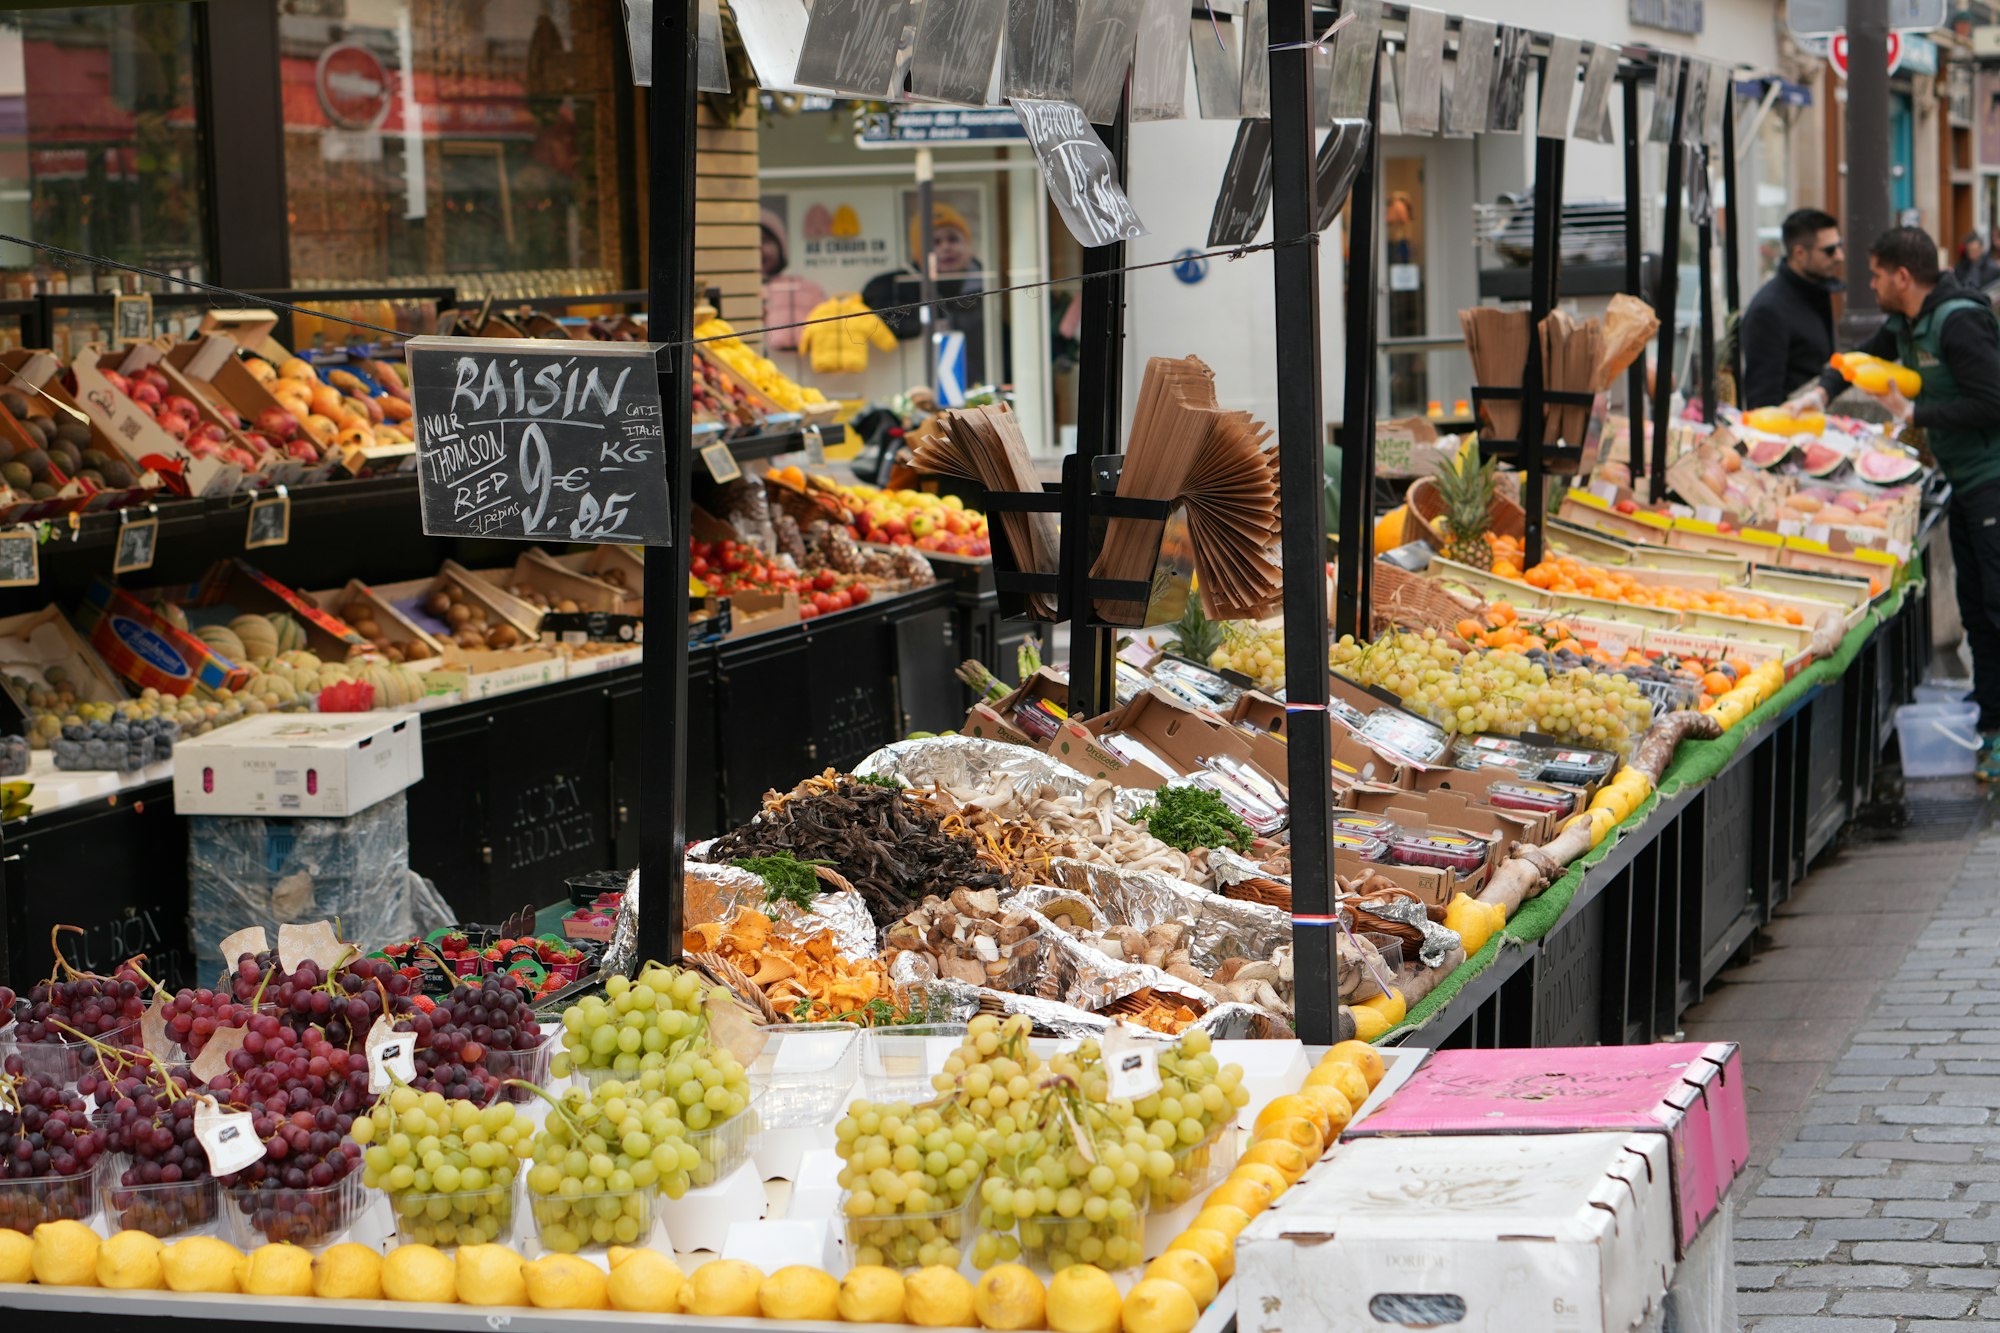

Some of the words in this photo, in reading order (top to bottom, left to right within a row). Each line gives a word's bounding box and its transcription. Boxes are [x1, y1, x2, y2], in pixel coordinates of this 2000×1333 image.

[424, 412, 465, 446] NOIR
[422, 422, 506, 484] THOMSON
[600, 441, 653, 464] KG
[454, 472, 508, 515] RED
[1386, 1254, 1446, 1269] DORIUM
